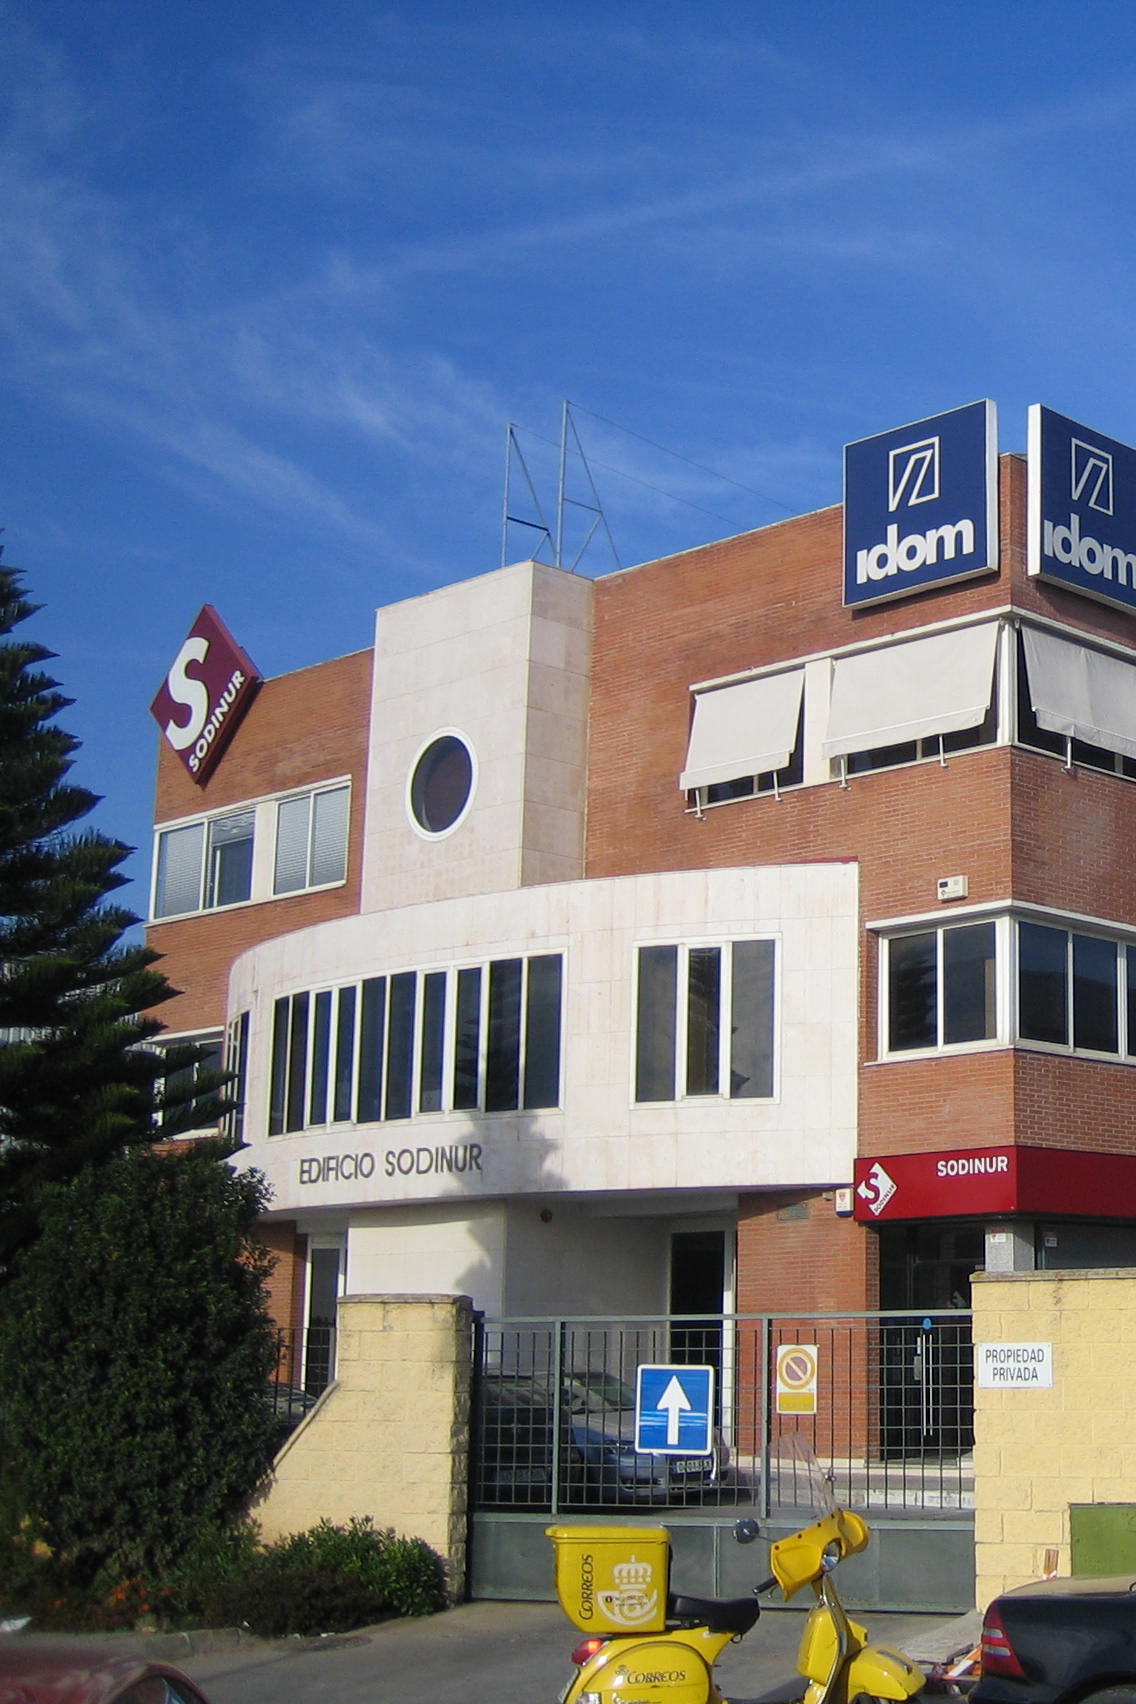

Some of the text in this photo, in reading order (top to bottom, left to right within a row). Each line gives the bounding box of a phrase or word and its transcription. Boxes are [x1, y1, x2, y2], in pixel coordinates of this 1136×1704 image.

[856, 519, 974, 584] idom
[188, 670, 245, 773] SODINUR
[299, 1143, 483, 1185] EDIFICIO SODINUR
[937, 1155, 1008, 1177] SODINUR
[985, 1348, 1045, 1364] PROPIEDAD
[992, 1366, 1039, 1382] PRIVADA
[579, 1554, 594, 1620] CORREOS
[627, 1670, 687, 1685] CORREOS
